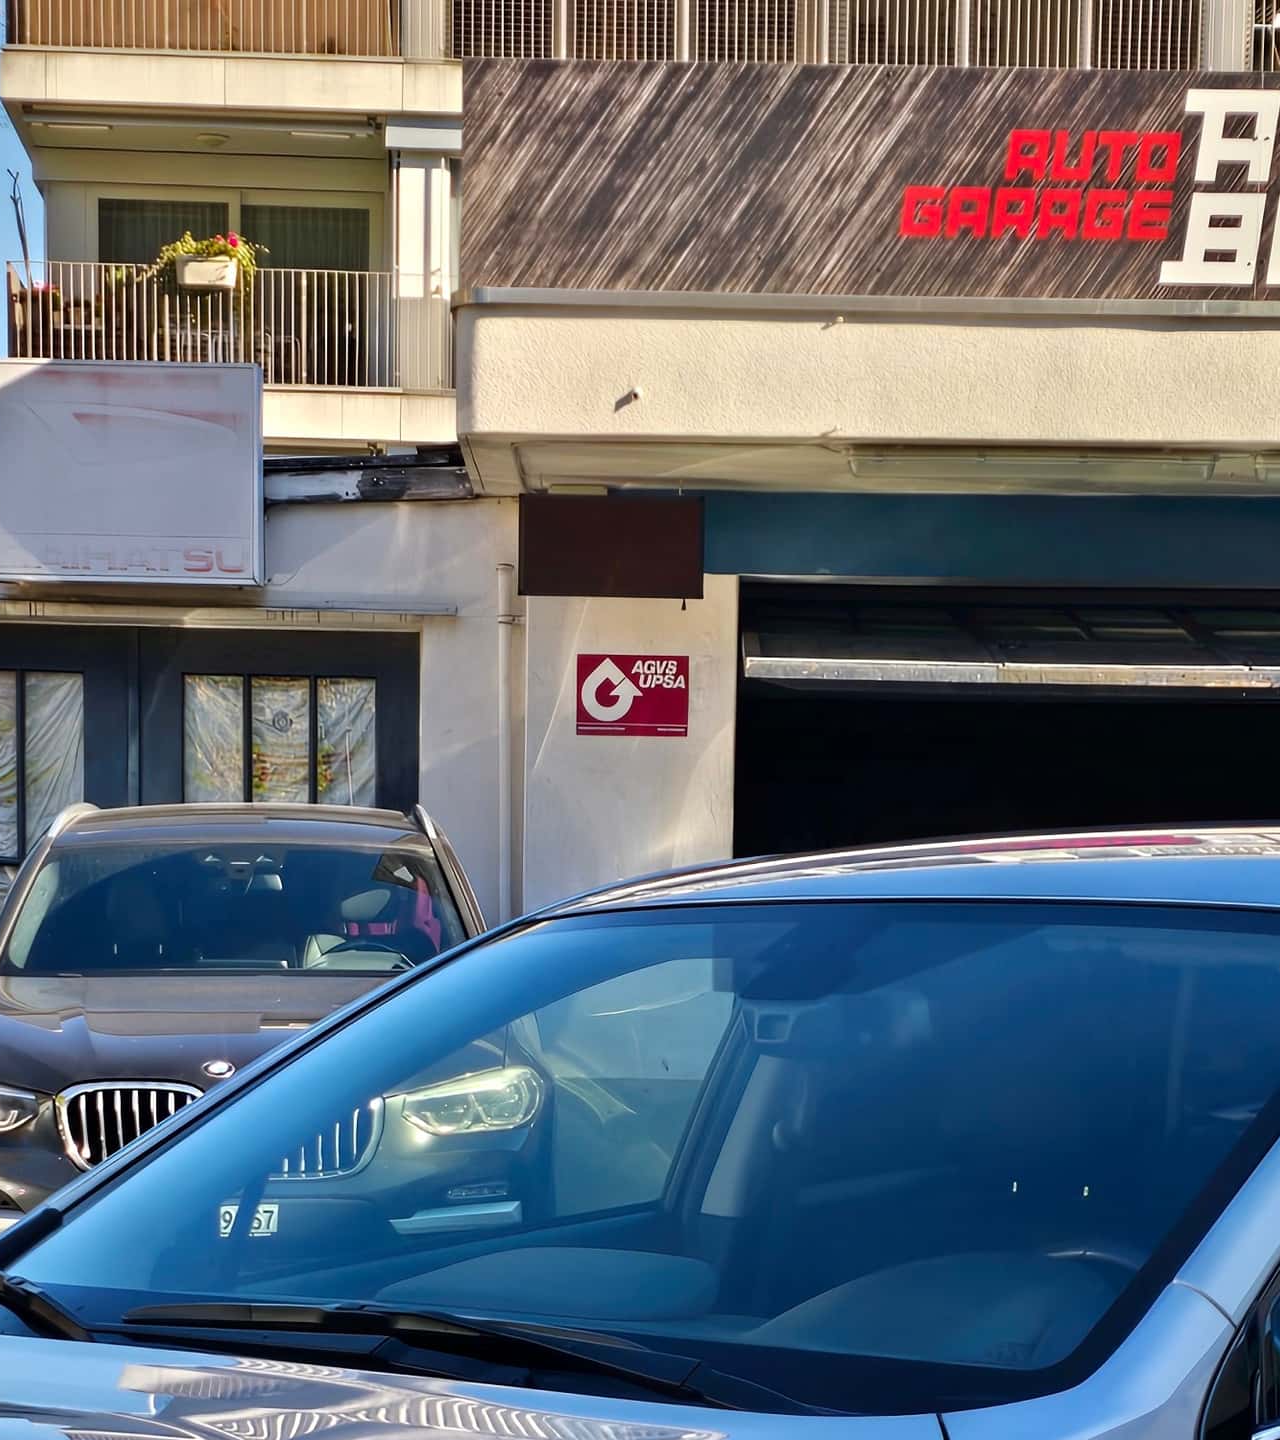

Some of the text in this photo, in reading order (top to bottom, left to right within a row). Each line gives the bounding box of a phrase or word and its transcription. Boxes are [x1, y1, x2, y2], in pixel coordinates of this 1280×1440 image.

[1004, 129, 1182, 182] AUTO
[898, 185, 1174, 240] GARAGE
[631, 660, 677, 674] AGVS
[639, 675, 686, 689] UPSA
